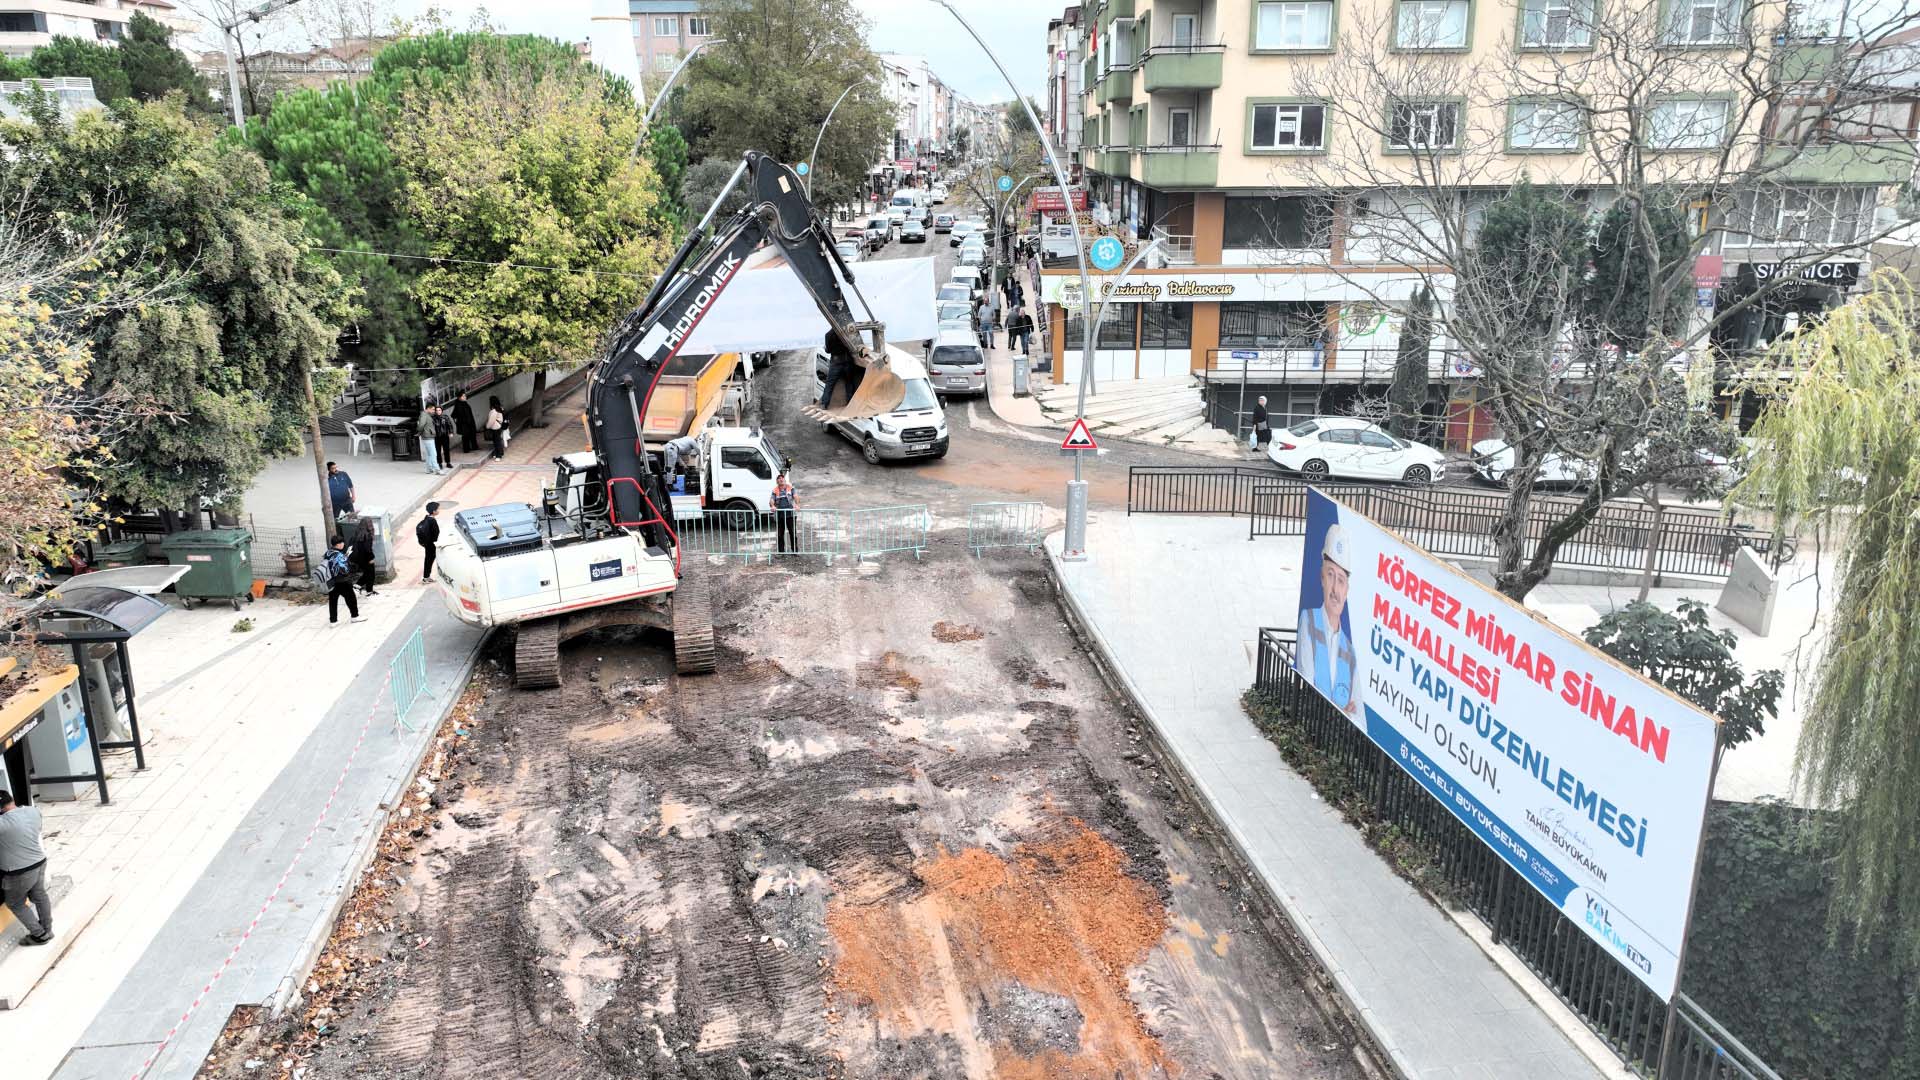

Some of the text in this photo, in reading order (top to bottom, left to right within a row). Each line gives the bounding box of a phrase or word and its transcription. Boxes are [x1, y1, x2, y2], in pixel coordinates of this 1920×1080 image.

[1102, 281, 1161, 300] Gaziantep
[1168, 281, 1235, 296] Baklavacısı
[1373, 594, 1500, 704] MAHALLESİ
[1377, 553, 1670, 764] KÖRFEZ MİMAR SİNAN
[1369, 669, 1501, 794] HAYIRLI OLSUN.
[1370, 625, 1405, 672] ÜST
[1410, 657, 1454, 712] YAPI
[1459, 695, 1648, 858] DÜZENLEMESİ
[1410, 752, 1454, 798] KOCAELİ
[1455, 791, 1528, 863] BÜYÜKŞEHİR
[1526, 809, 1551, 837] TAHİR
[1552, 831, 1607, 883] BÜYÜKAKIN
[1585, 892, 1612, 928] YOL
